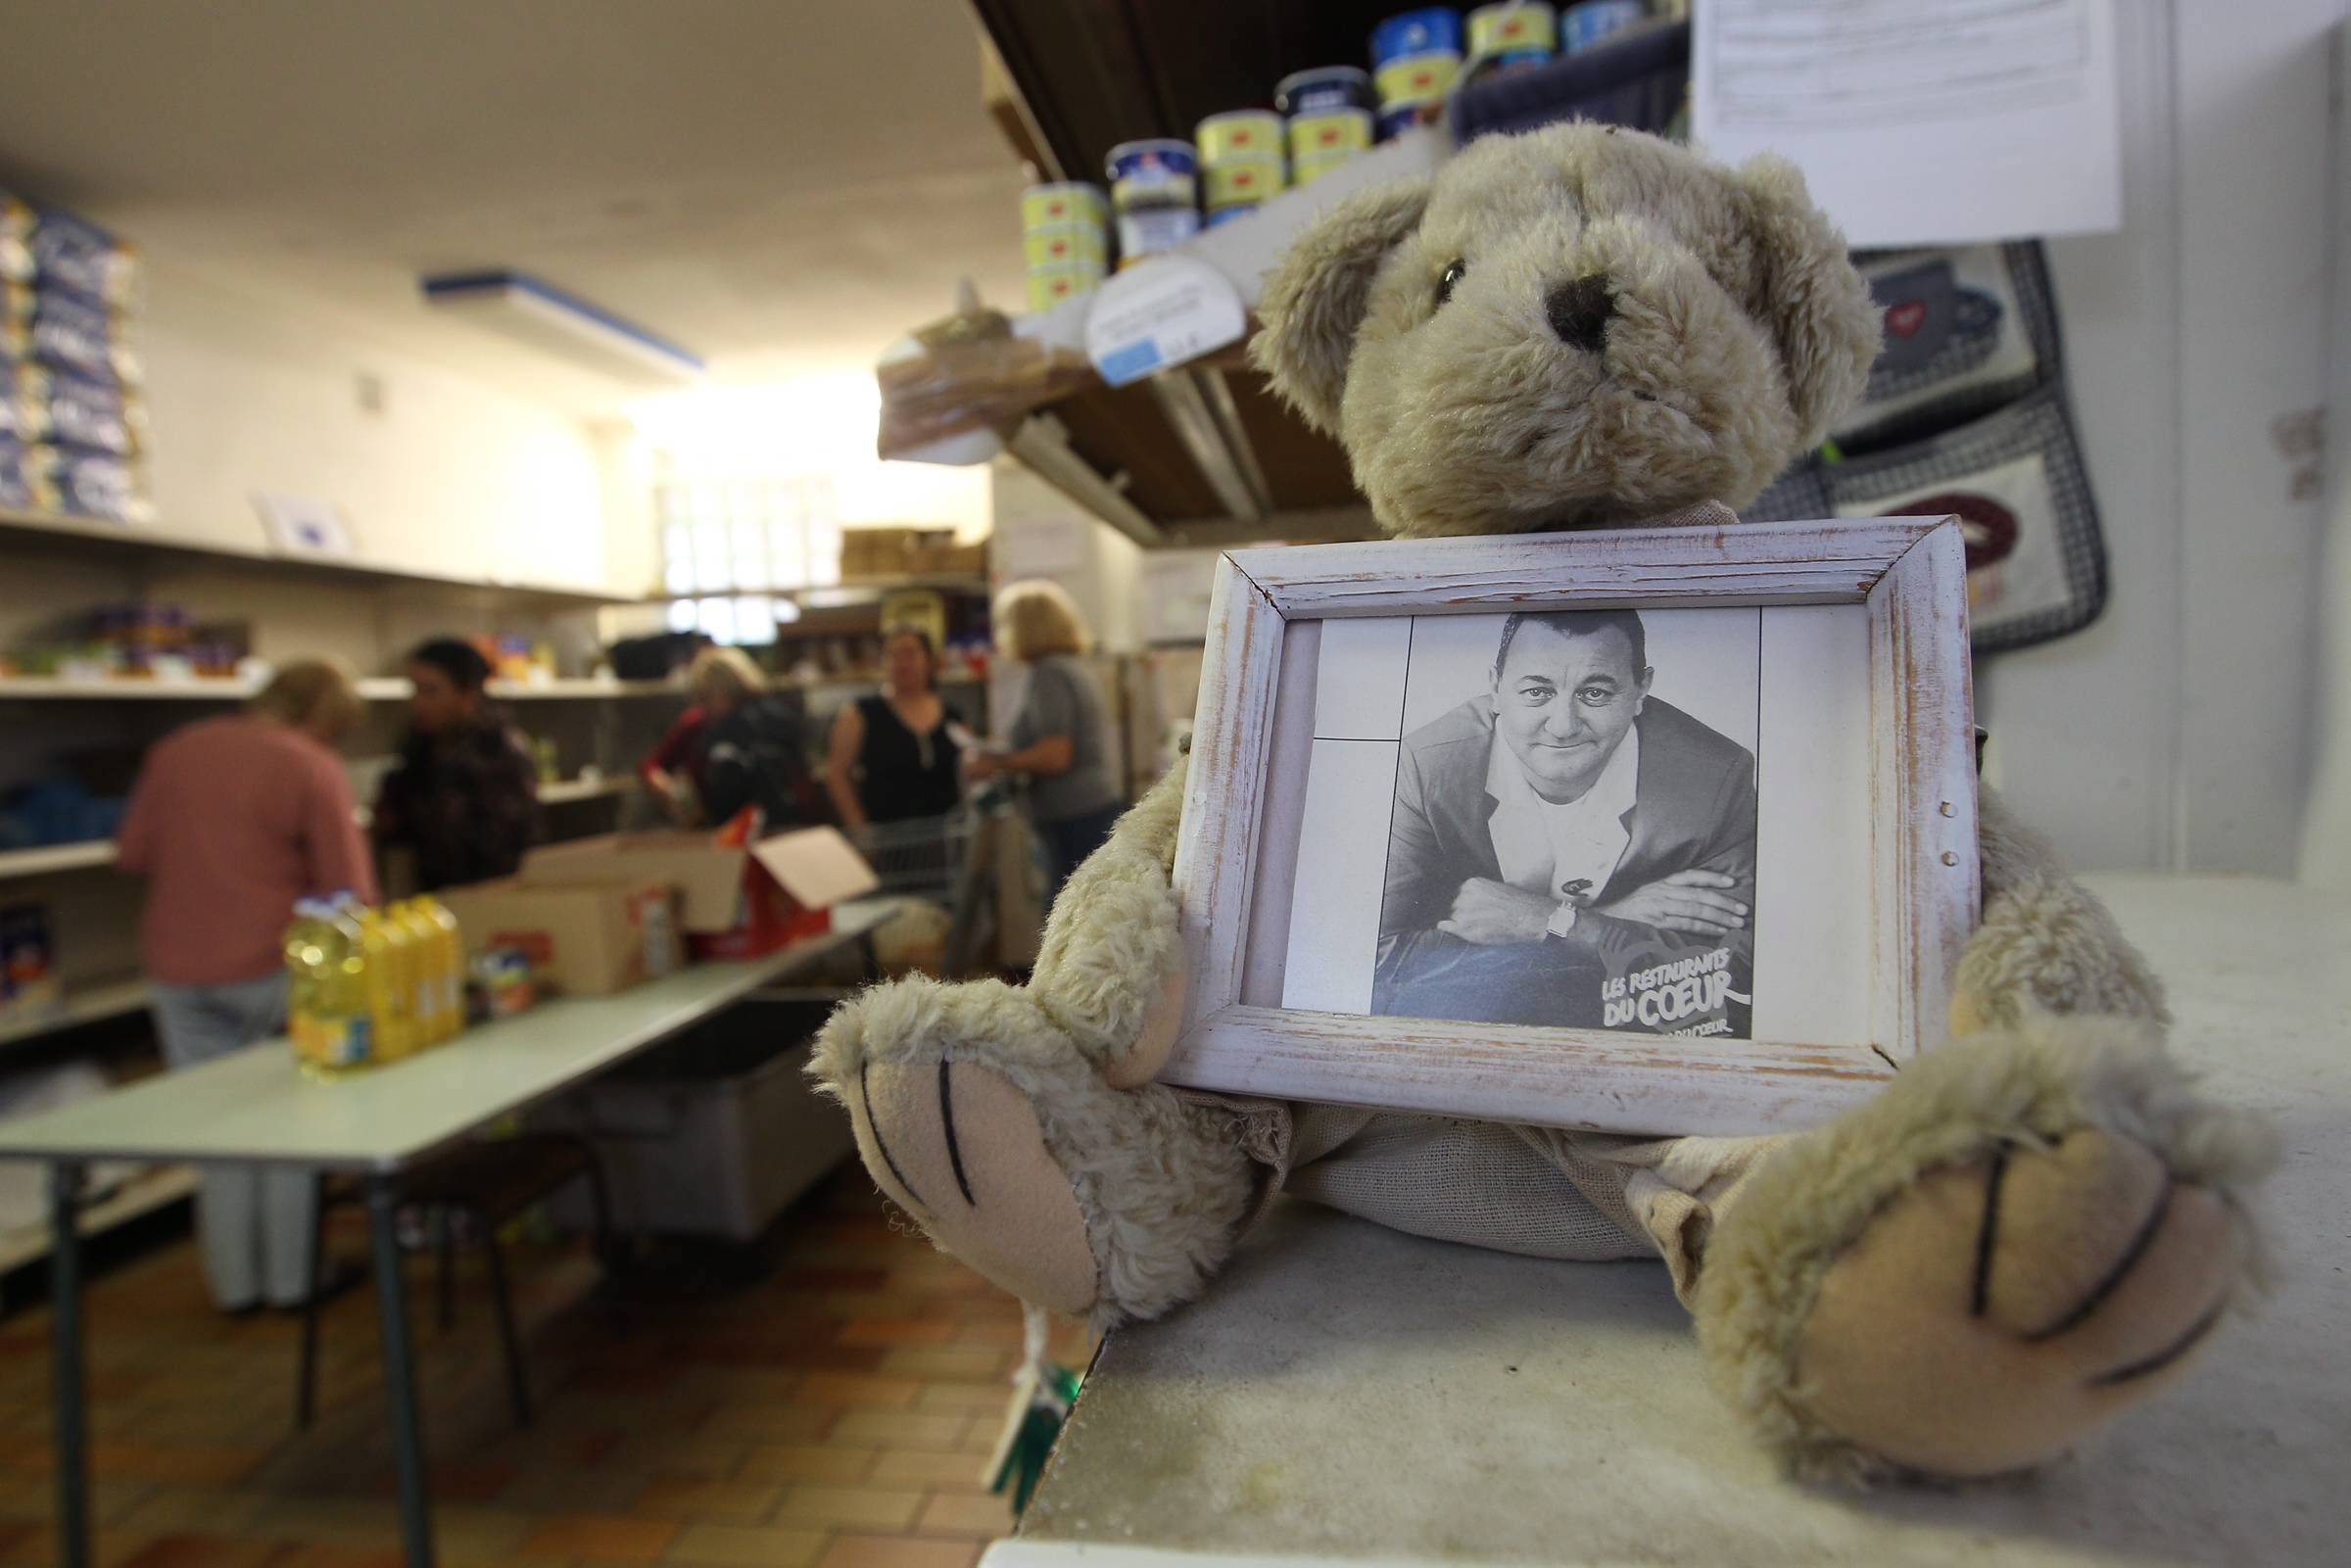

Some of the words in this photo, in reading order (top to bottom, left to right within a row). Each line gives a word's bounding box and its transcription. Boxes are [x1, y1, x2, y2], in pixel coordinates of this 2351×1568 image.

[1603, 977, 1626, 1000] LES
[1630, 948, 1730, 993] RESTAURANTS
[1604, 998, 1635, 1026] DU
[1639, 972, 1751, 1025] COEUR
